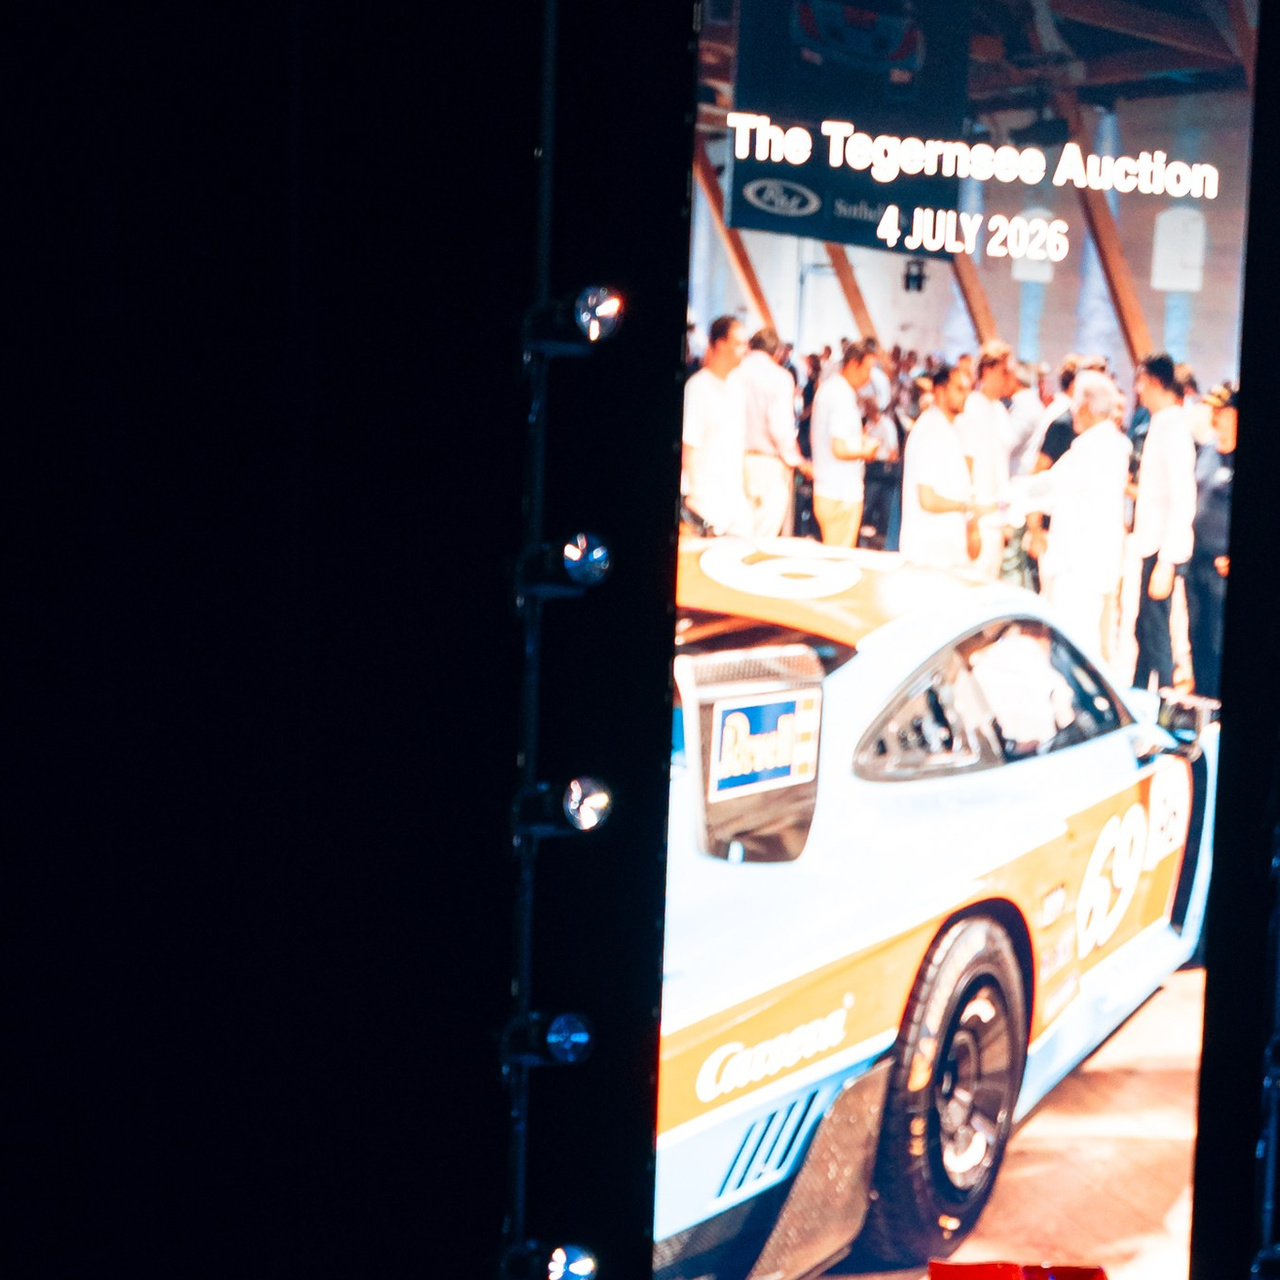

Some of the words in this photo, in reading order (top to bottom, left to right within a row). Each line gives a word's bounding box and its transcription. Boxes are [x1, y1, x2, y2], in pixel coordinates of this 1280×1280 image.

[726, 112, 812, 164] The
[821, 120, 1047, 183] Tegernsee
[1052, 141, 1220, 200] Auction
[876, 204, 902, 249] 4
[903, 206, 983, 256] JULY
[986, 213, 1071, 263] 2026
[1076, 803, 1148, 960] 69
